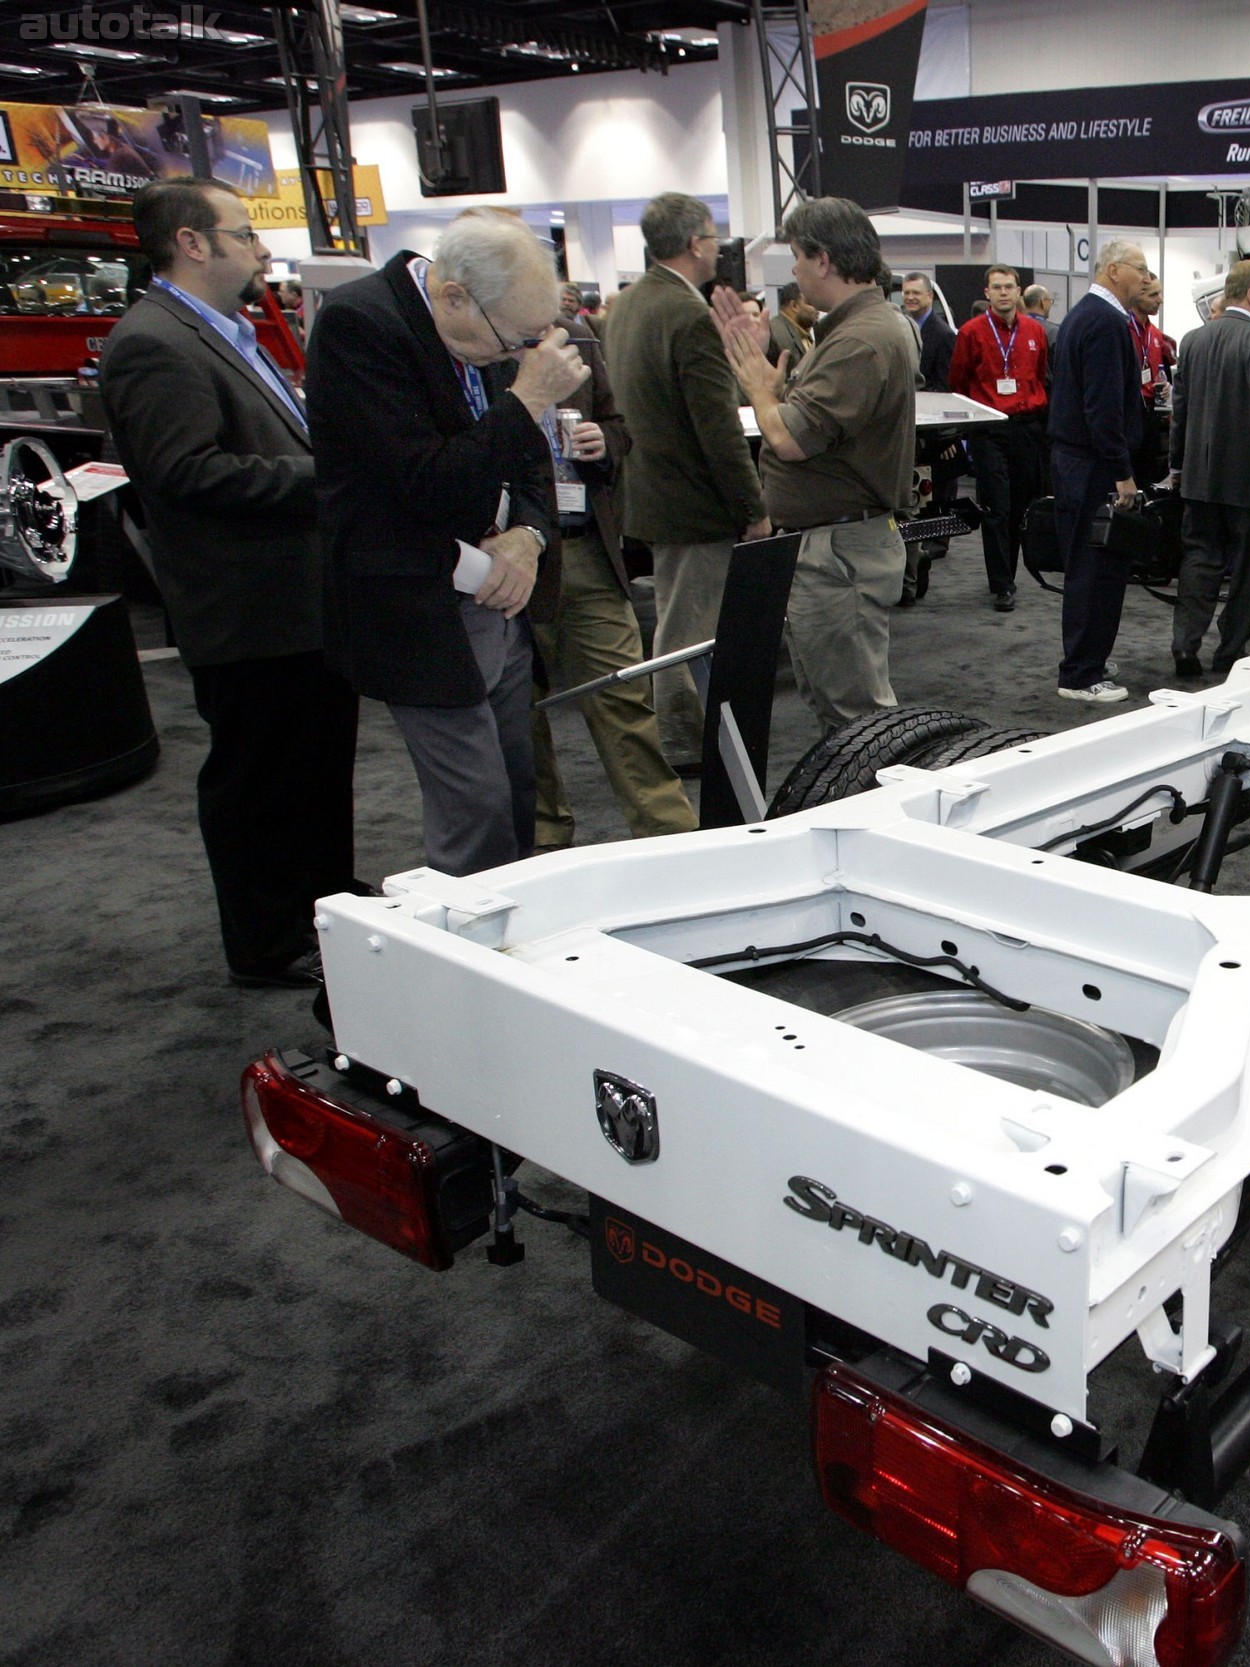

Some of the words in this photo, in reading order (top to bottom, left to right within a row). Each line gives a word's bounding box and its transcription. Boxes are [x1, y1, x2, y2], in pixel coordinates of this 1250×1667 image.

[841, 135, 896, 147] DODGE
[908, 131, 931, 147] FOR
[935, 128, 979, 147] BETTER
[982, 123, 1046, 143] BUSINESS
[1048, 121, 1077, 140] AND
[1080, 117, 1152, 138] LIFESTYLE
[642, 1241, 781, 1329] DODGE
[783, 1175, 1054, 1329] SPRINTER
[926, 1303, 1051, 1373] CRD
